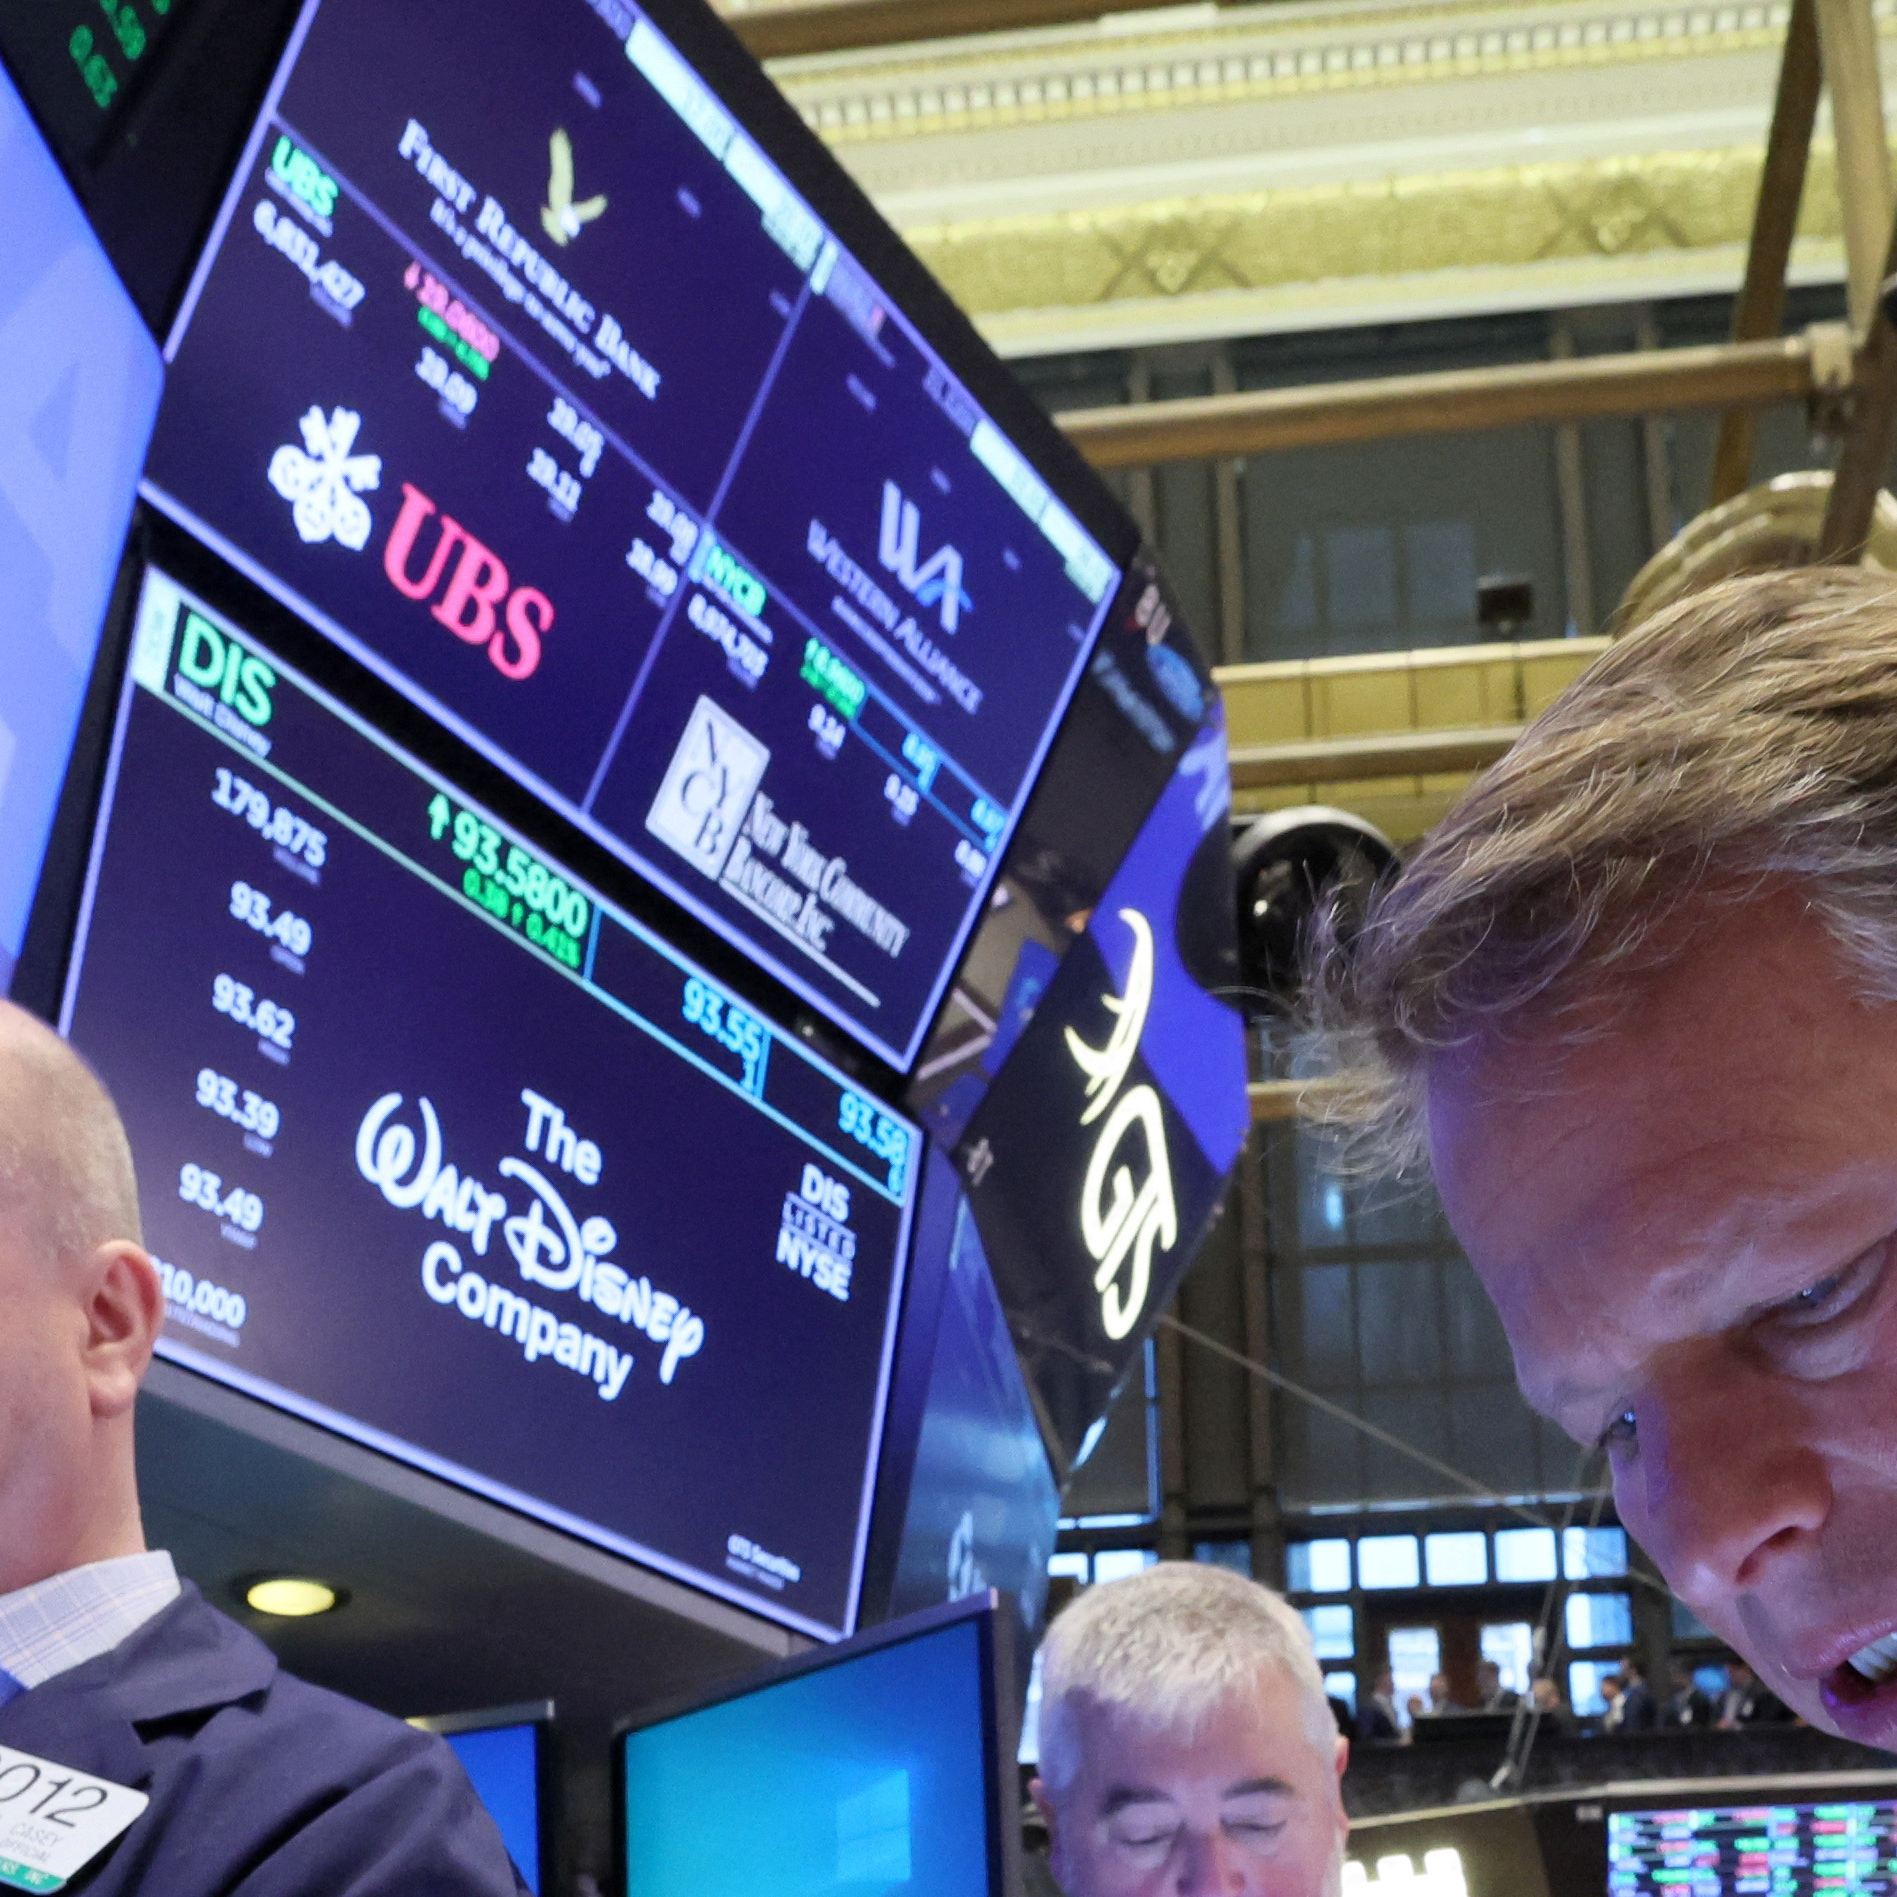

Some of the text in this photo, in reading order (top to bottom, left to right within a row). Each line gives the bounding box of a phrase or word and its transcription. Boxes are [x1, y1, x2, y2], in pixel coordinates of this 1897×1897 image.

[273, 136, 338, 219] UBS
[384, 483, 554, 679] UBS
[179, 613, 275, 725] DIS
[212, 769, 326, 866] 179,875
[453, 811, 588, 938] 93.5800
[230, 882, 311, 955] 93.49
[213, 974, 294, 1048] 93.62
[683, 978, 764, 1069] 93.55
[196, 1069, 279, 1138] 93.39
[522, 1089, 601, 1185] The
[179, 1164, 263, 1231] 93.49
[796, 1164, 850, 1233] DIS
[777, 1223, 851, 1301] NYSE
[422, 1242, 633, 1400] Company
